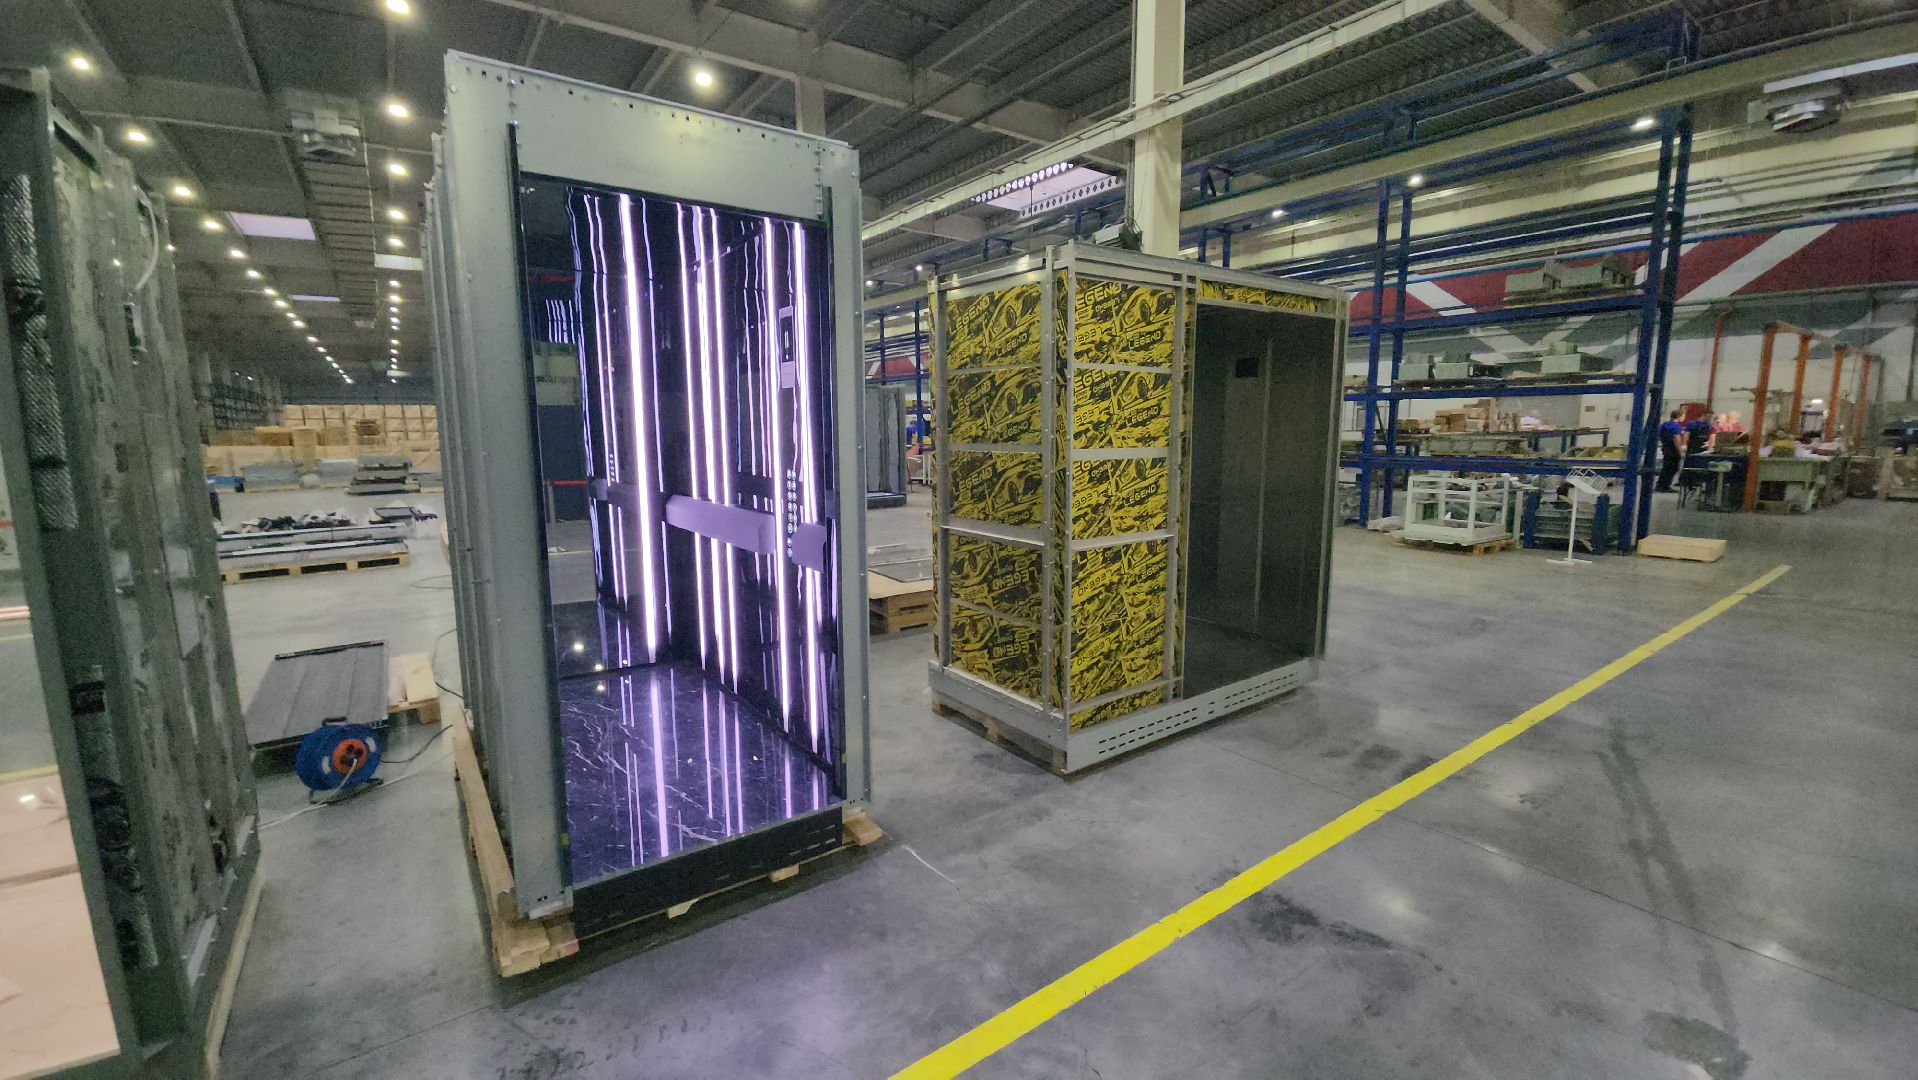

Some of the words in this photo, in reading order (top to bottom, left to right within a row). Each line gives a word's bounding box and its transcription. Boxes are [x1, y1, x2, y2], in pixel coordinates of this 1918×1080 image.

[1076, 283, 1122, 309] EGEND
[949, 295, 990, 336] LEGEND
[1128, 331, 1161, 350] LEGEND
[1126, 407, 1159, 426] LEGEND
[953, 466, 993, 495] LEGEND
[1124, 484, 1157, 506] LEGEND
